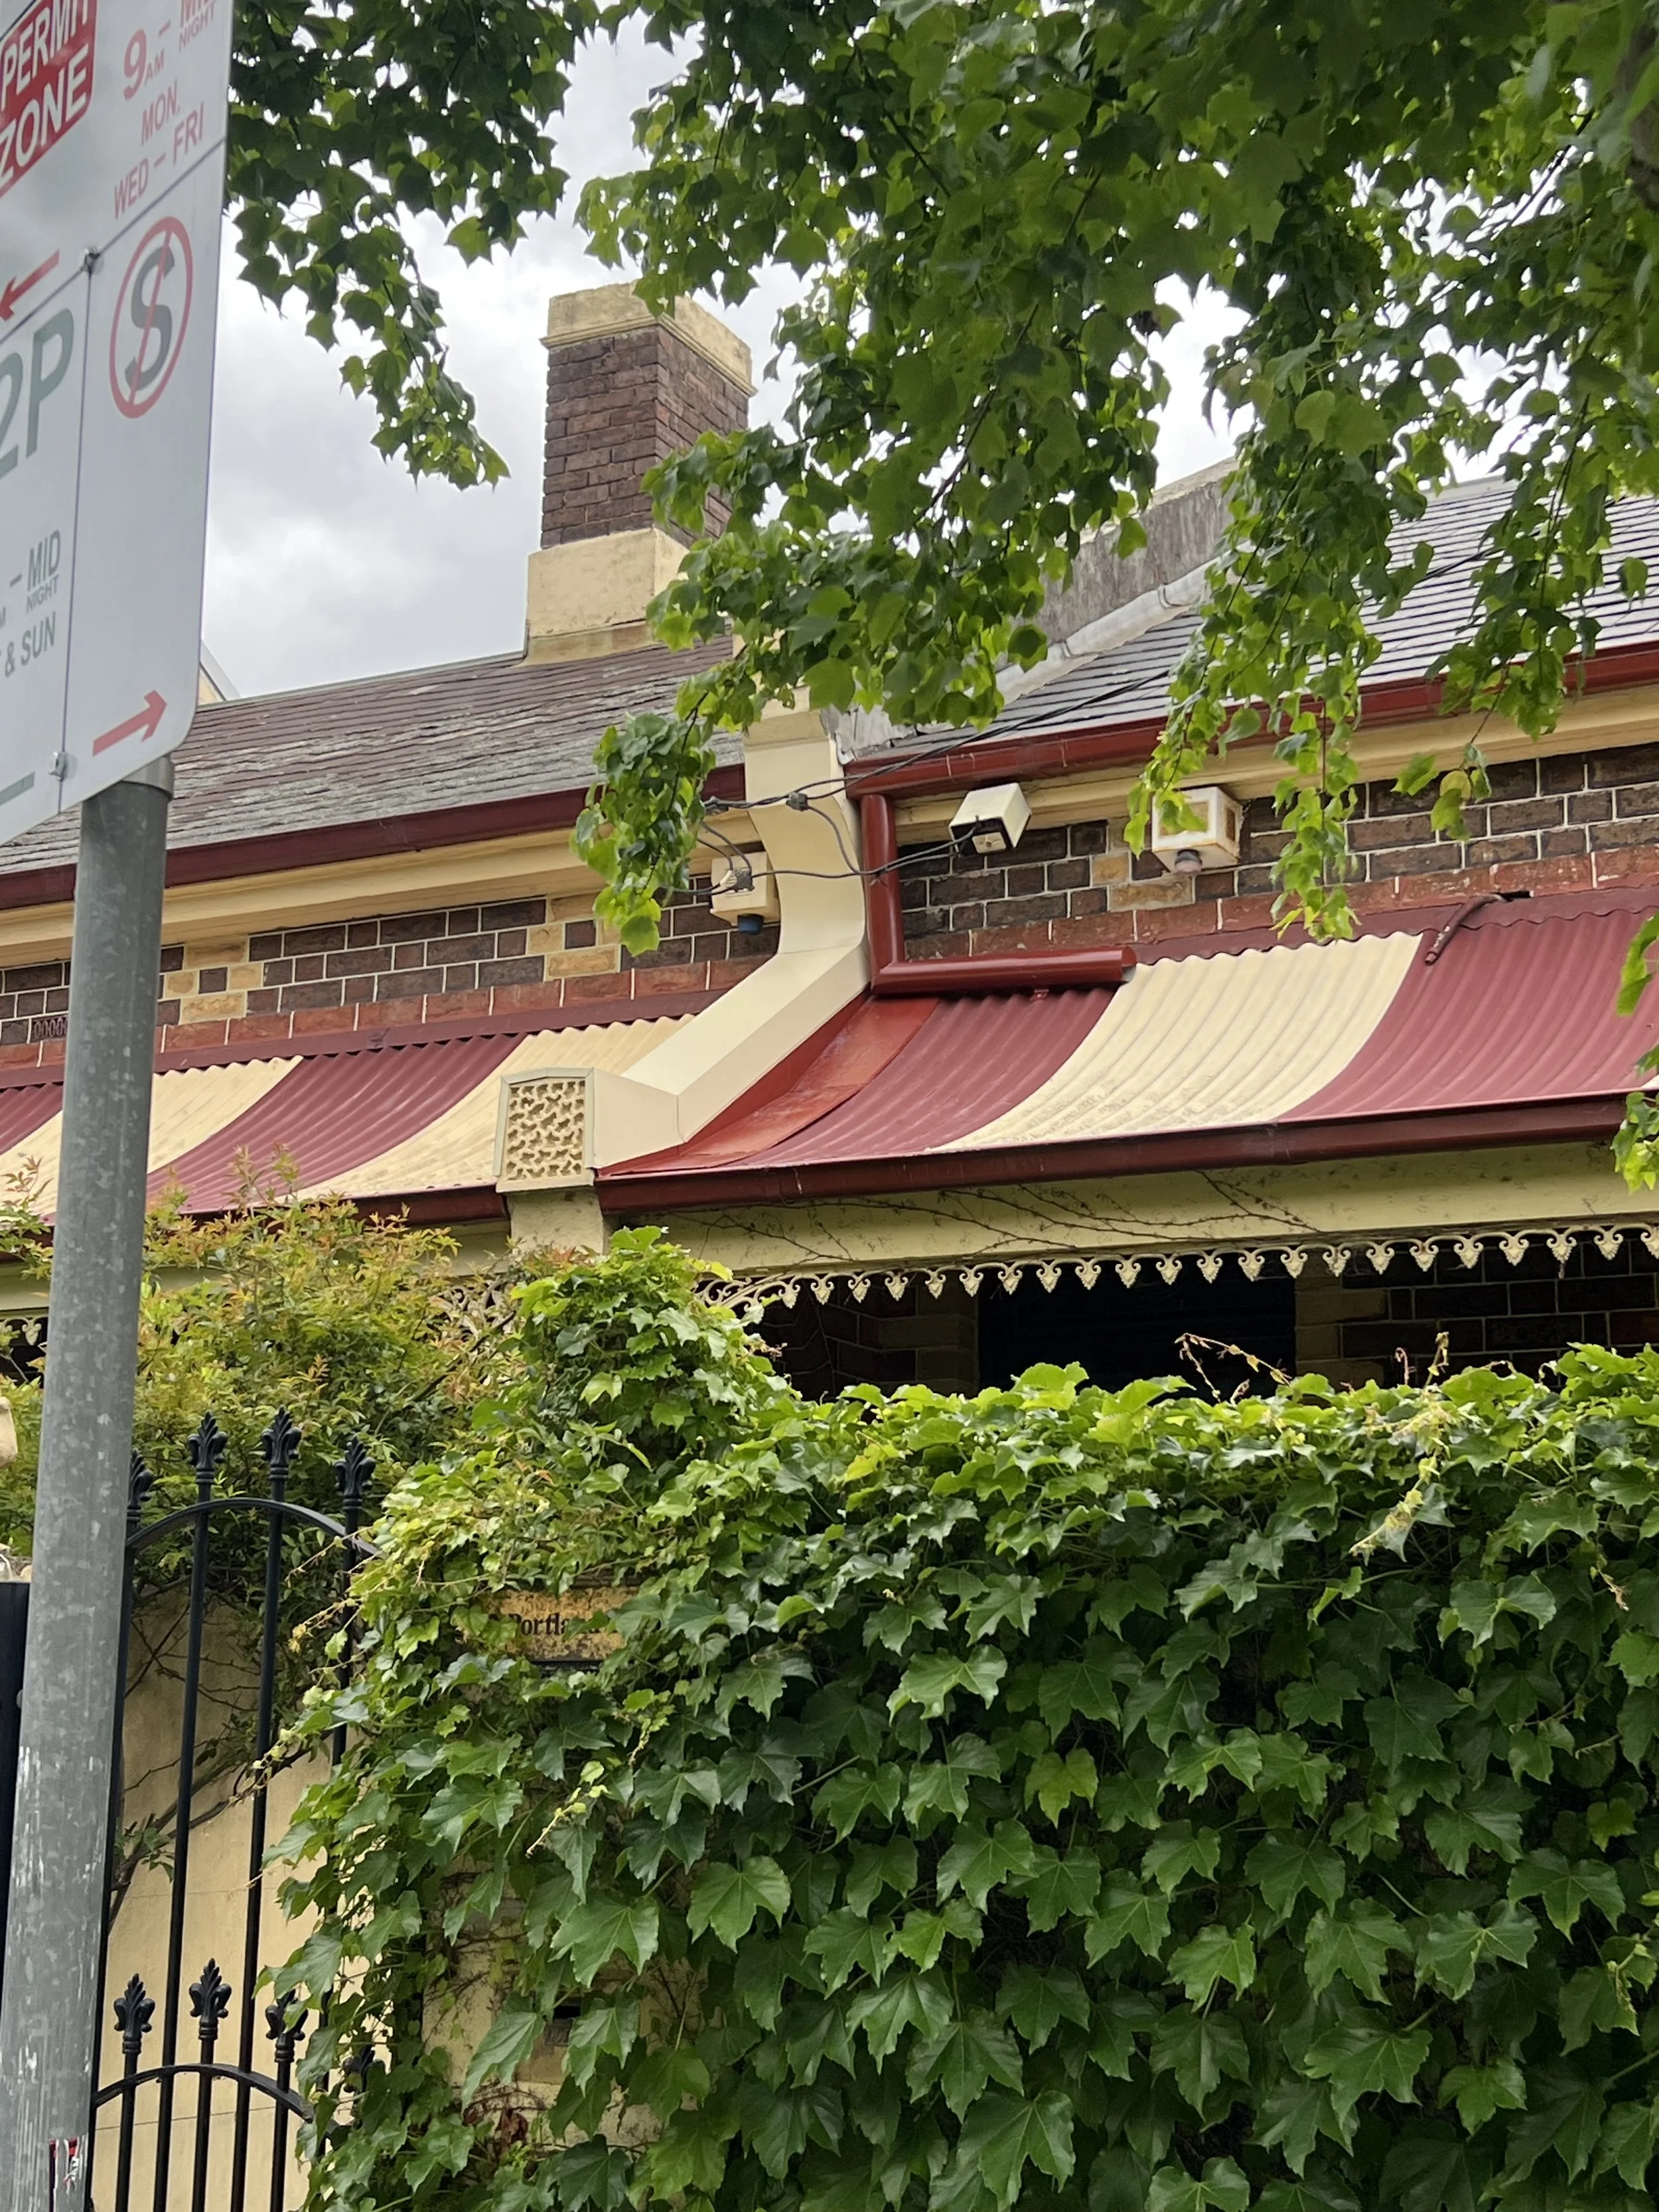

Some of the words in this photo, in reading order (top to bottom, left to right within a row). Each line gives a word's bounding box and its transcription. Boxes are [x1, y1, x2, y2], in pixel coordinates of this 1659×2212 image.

[0, 44, 89, 188] ZONE
[114, 157, 149, 220] WED
[173, 101, 204, 166] FRI
[0, 307, 74, 480] 2P
[26, 574, 60, 615] NIGHT
[27, 530, 60, 592] MID
[21, 611, 56, 666] SUN
